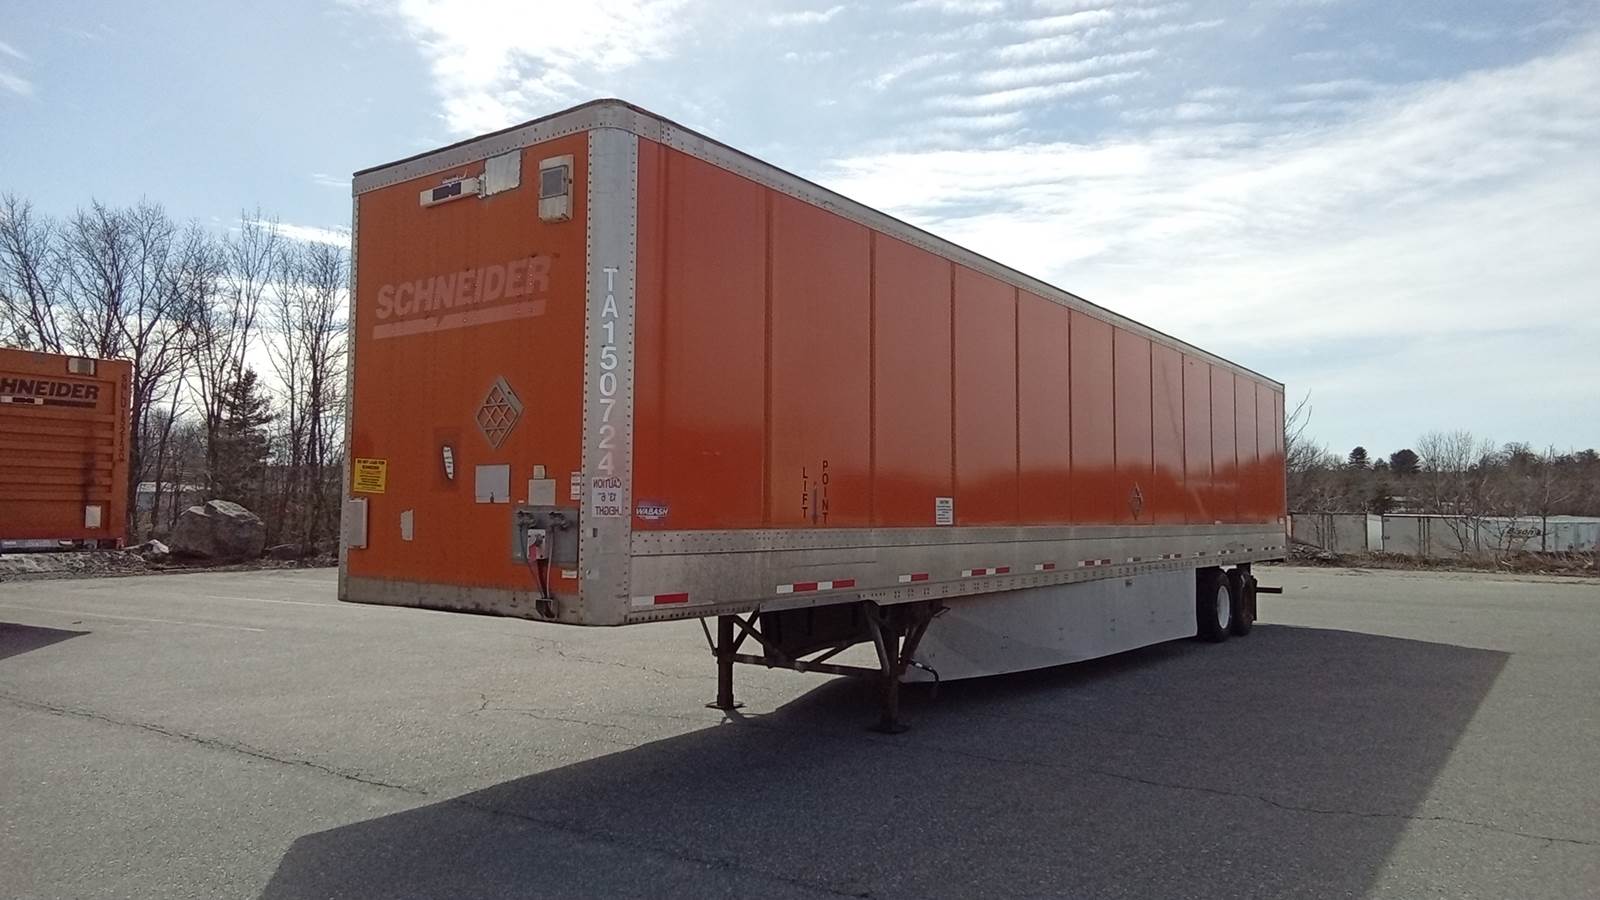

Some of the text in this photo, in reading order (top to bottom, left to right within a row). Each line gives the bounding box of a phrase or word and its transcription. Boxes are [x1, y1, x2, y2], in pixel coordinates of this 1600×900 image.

[375, 255, 550, 319] SCHNEIDER
[599, 267, 619, 475] TA150724
[635, 506, 668, 515] WABASH
